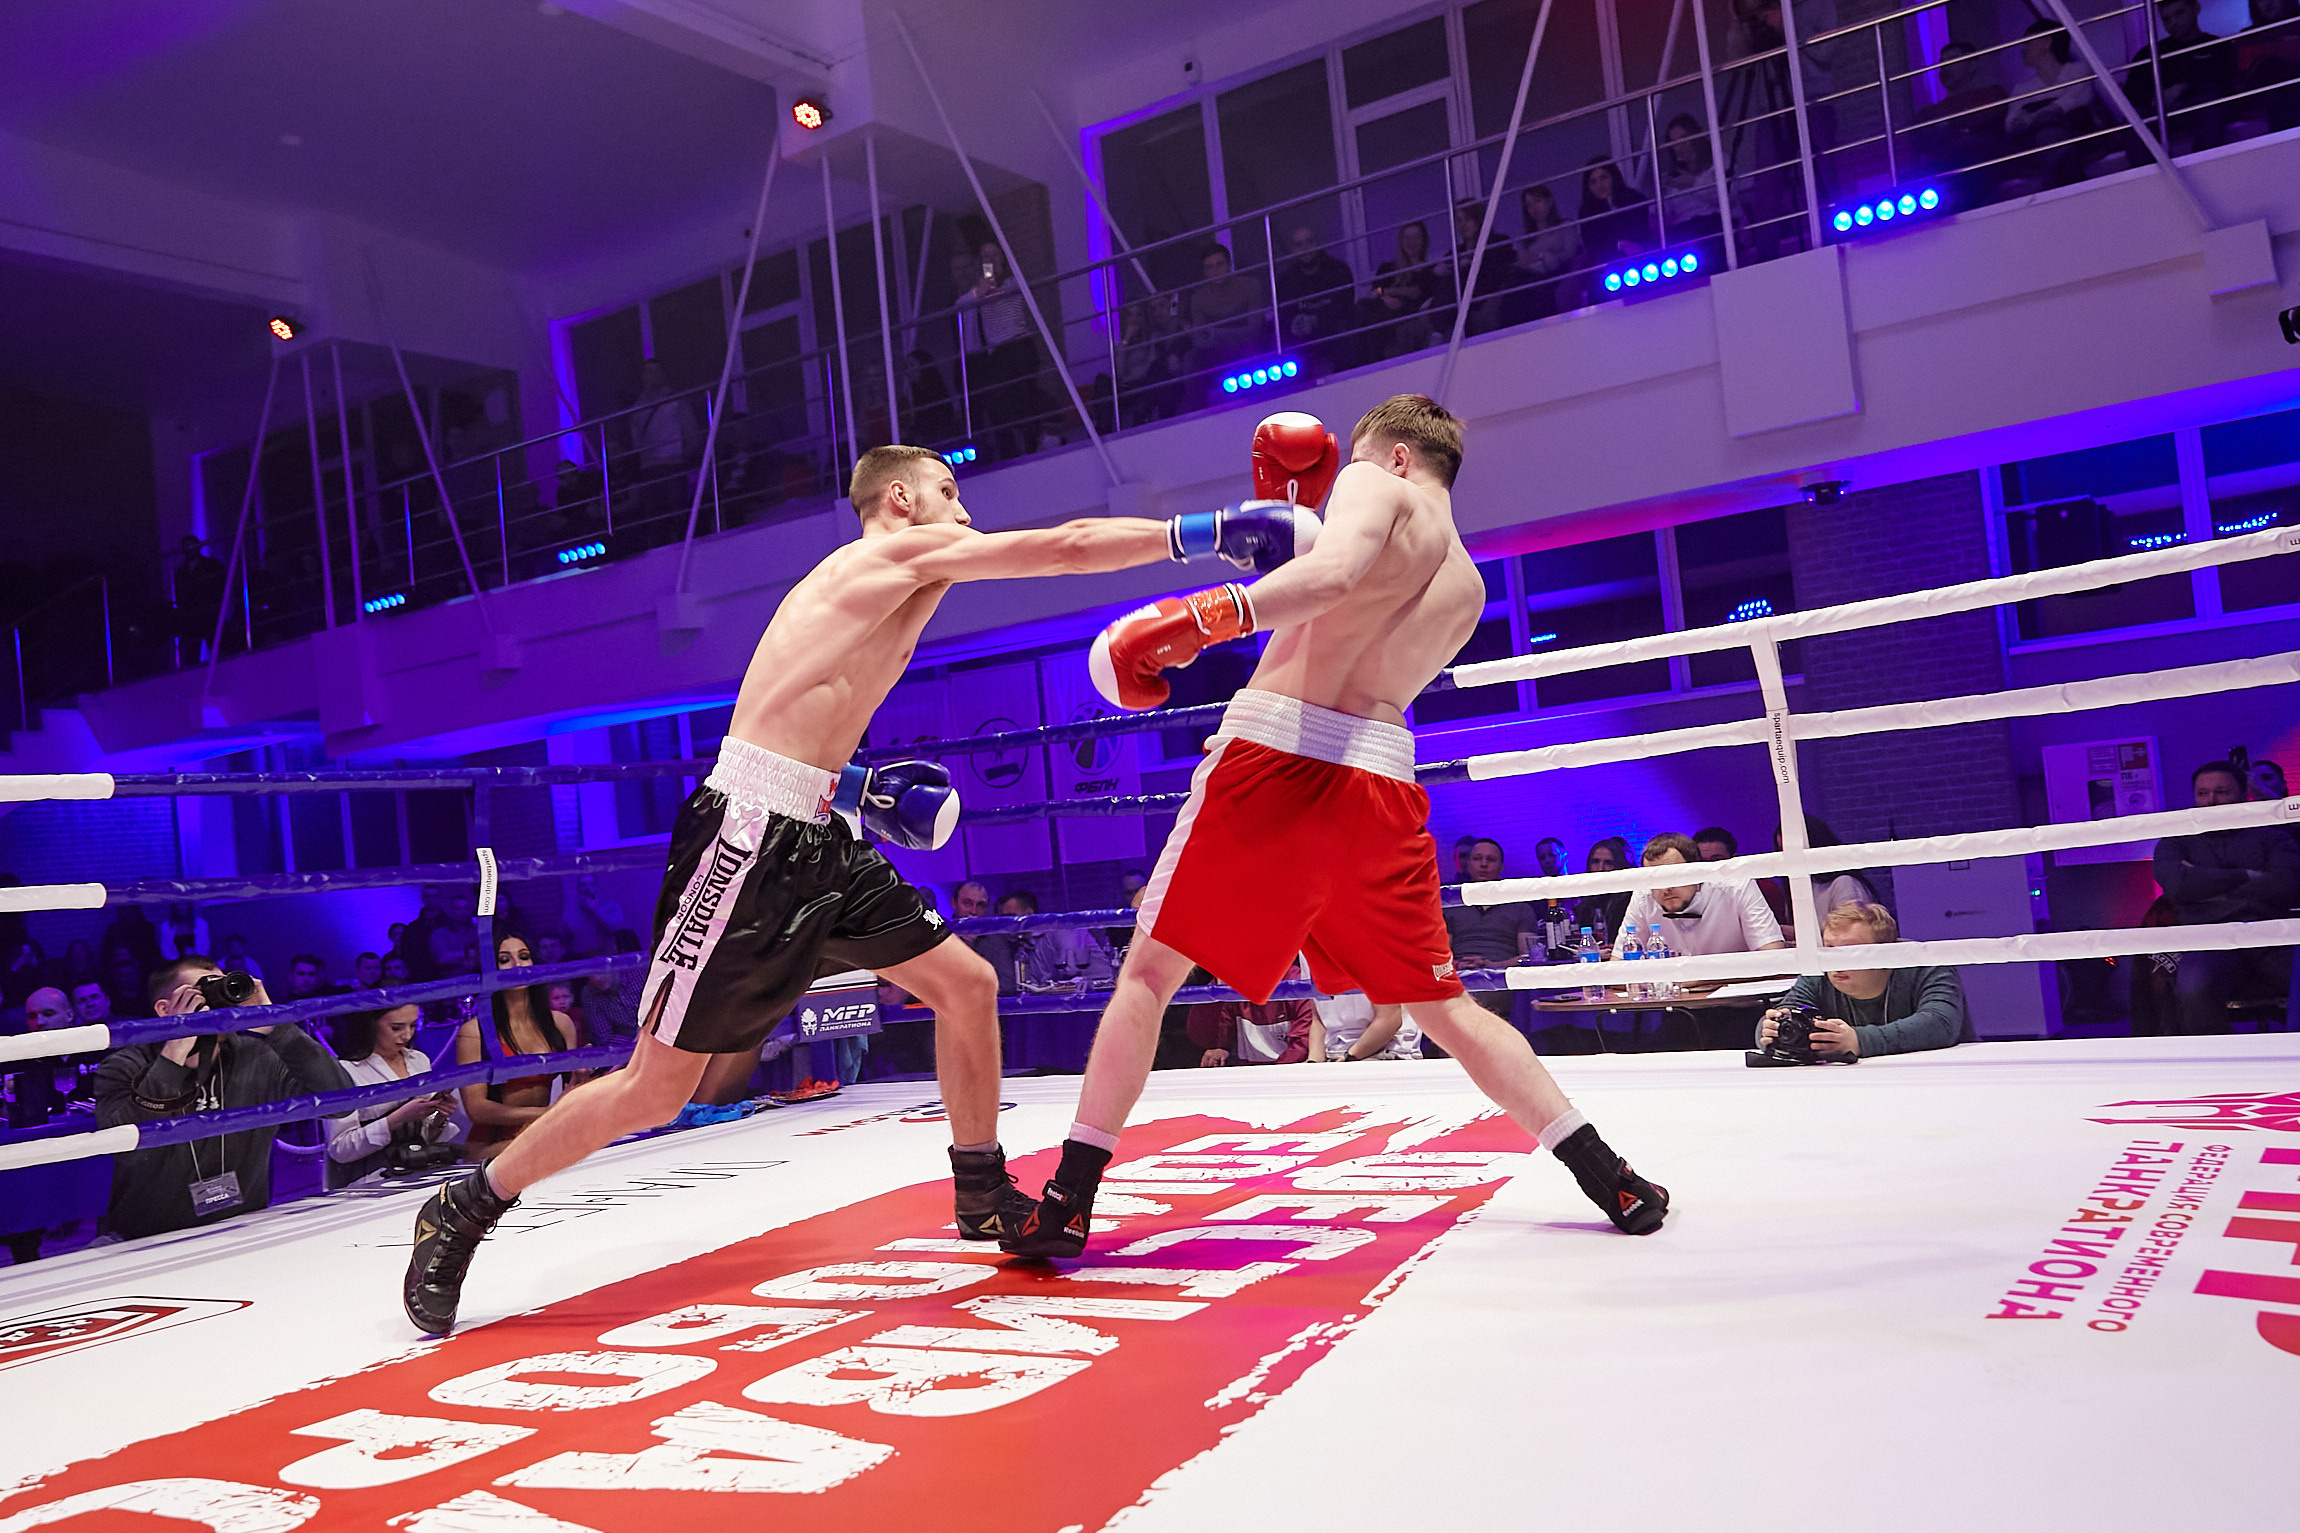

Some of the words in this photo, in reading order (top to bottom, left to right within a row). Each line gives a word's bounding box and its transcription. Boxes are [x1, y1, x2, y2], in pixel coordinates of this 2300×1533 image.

[1773, 713, 1790, 784] spartaequip.com
[659, 837, 753, 971] LONSDALE
[677, 874, 704, 920] LONDON
[821, 1003, 877, 1022] MFP
[136, 1096, 165, 1109] Canon
[2167, 1144, 2233, 1211] ФЕДЕРАЦИЯ
[1985, 1140, 2184, 1319] ПАНКРАТИОНА
[2087, 1213, 2194, 1332] СОВРЕМЕННОГО
